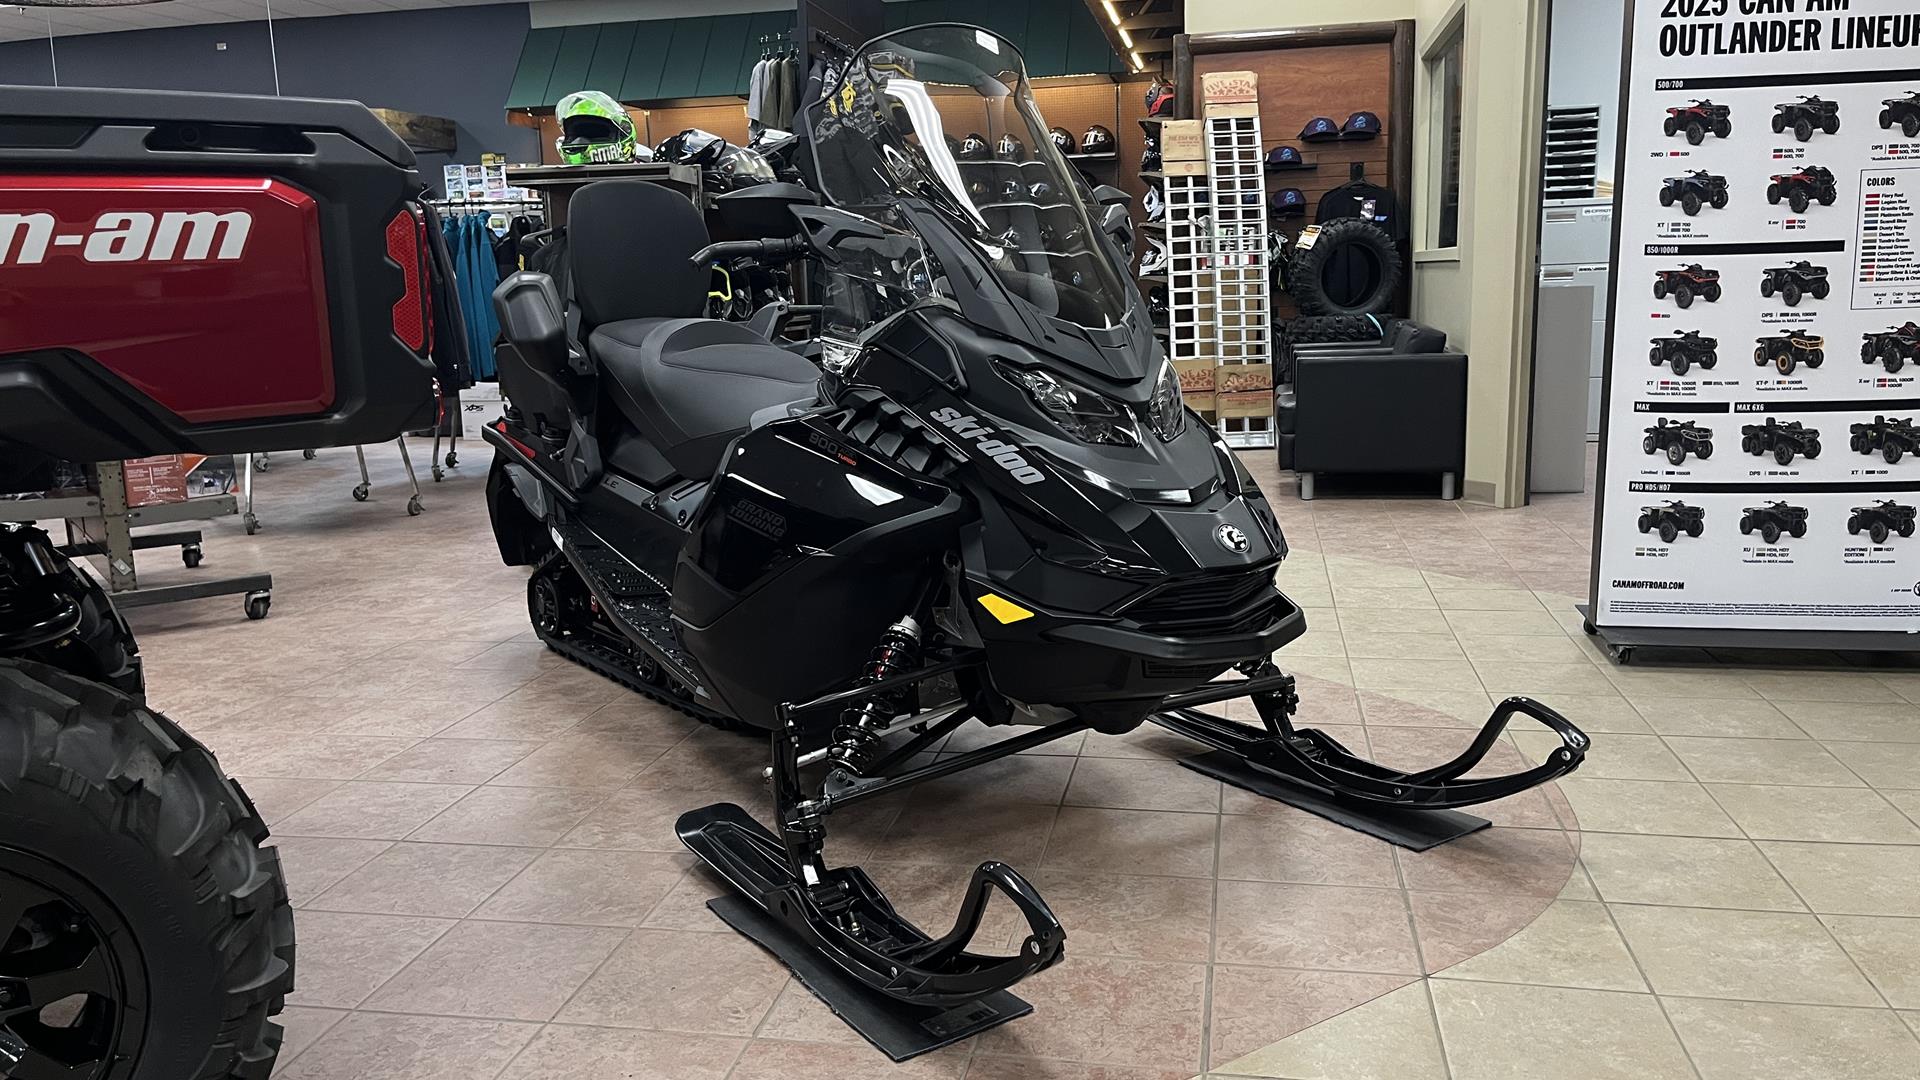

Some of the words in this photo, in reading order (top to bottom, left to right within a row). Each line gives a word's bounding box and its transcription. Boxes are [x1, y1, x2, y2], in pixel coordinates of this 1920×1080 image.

[1660, 0, 1728, 18] 2025
[1659, 19, 1822, 57] OUTLANDER
[1205, 80, 1225, 93] FIVE
[1657, 80, 1684, 89] 500/700
[1866, 177, 1896, 186] COLORS
[0, 211, 252, 264] n-am
[1646, 246, 1679, 254] 850/1000R
[1636, 403, 1650, 411] MAX
[1736, 403, 1751, 411] MAX
[1751, 403, 1765, 411] 6X6
[808, 432, 839, 455] 900
[930, 406, 1046, 485] ski-doo
[837, 452, 857, 467] TURBO
[1644, 483, 1671, 491] HD5/HD7
[729, 504, 785, 537] TOURING
[736, 500, 784, 527] GRAND
[1612, 579, 1685, 590] CANAMOFFROAD.COM
